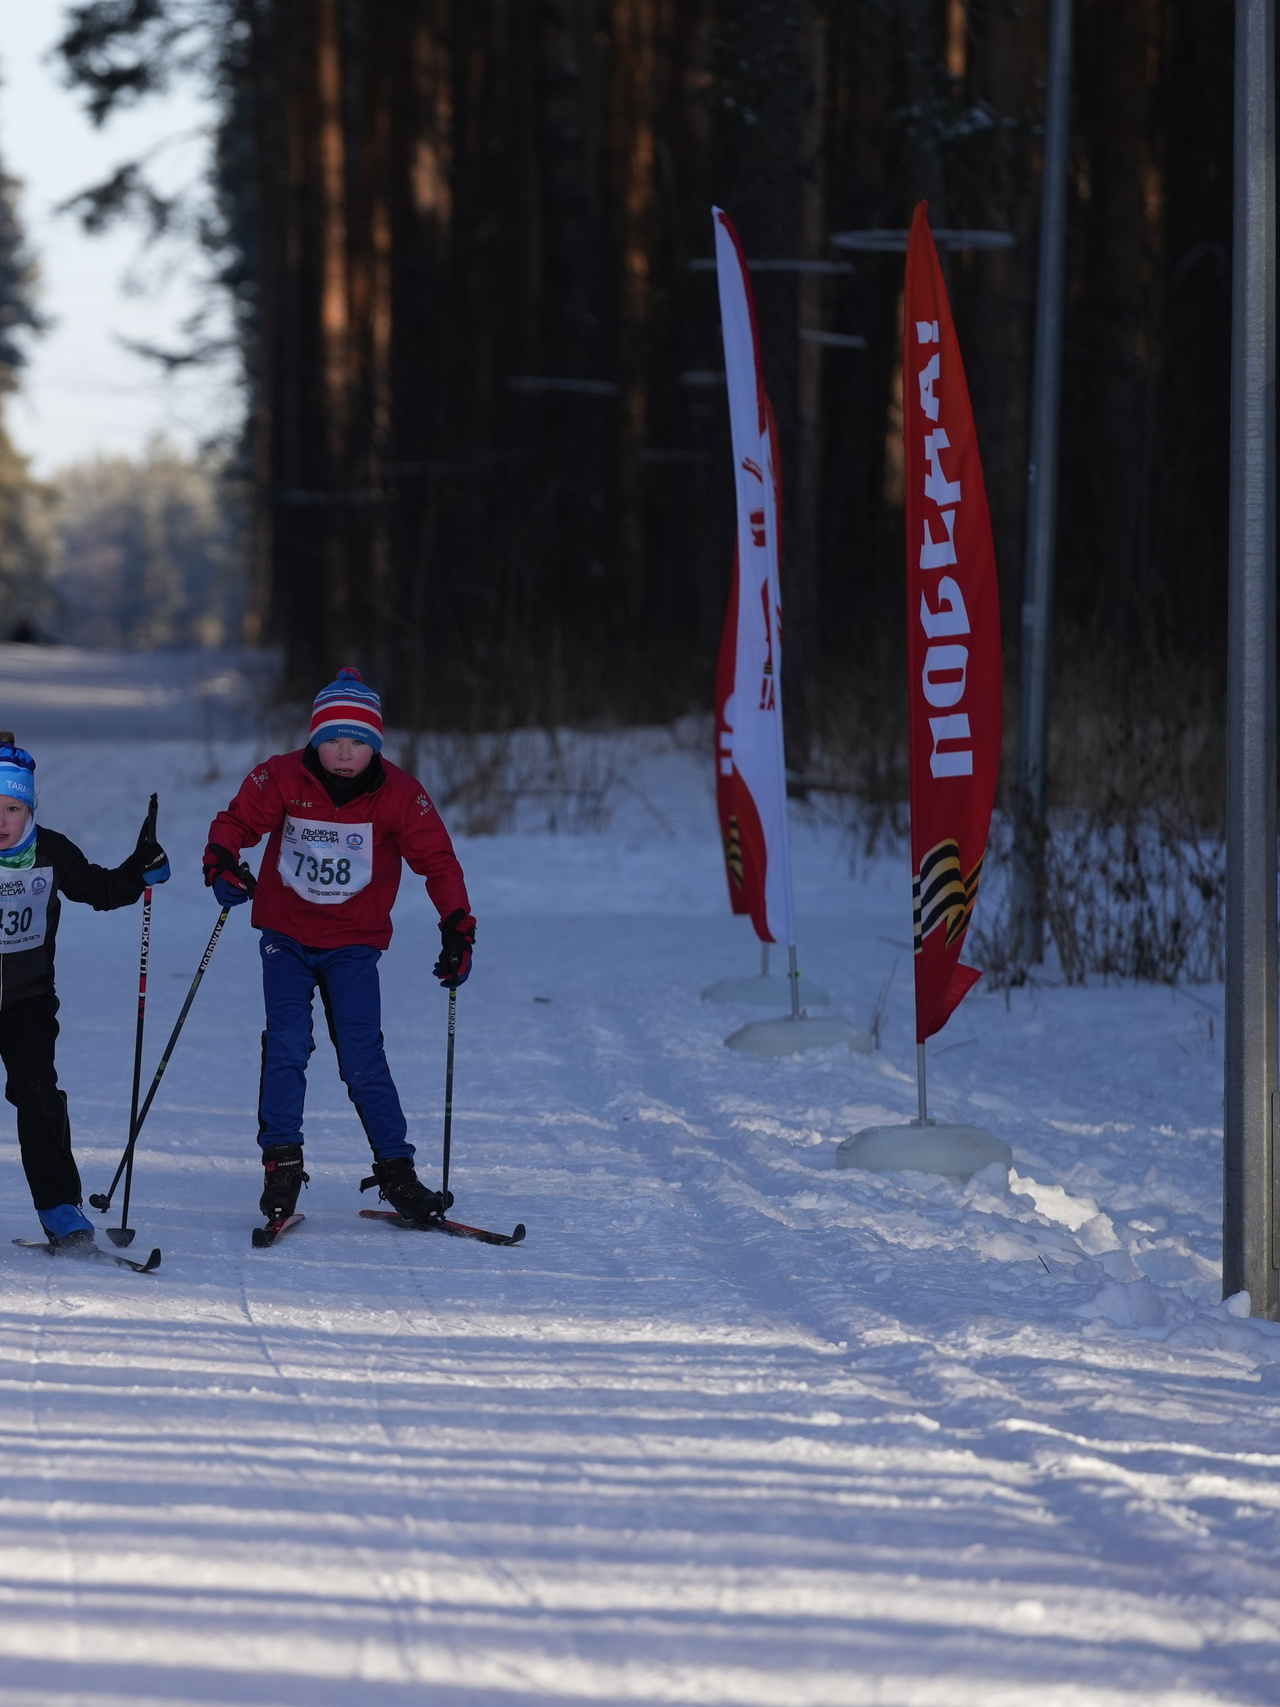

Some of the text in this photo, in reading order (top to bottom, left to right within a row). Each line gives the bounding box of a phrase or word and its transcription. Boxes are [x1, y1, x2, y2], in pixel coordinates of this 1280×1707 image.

[302, 835, 339, 843] РОССИИ
[303, 828, 338, 837] ЛЫЖНЯ
[292, 850, 351, 885] 7358
[200, 922, 223, 972] NORDWAY
